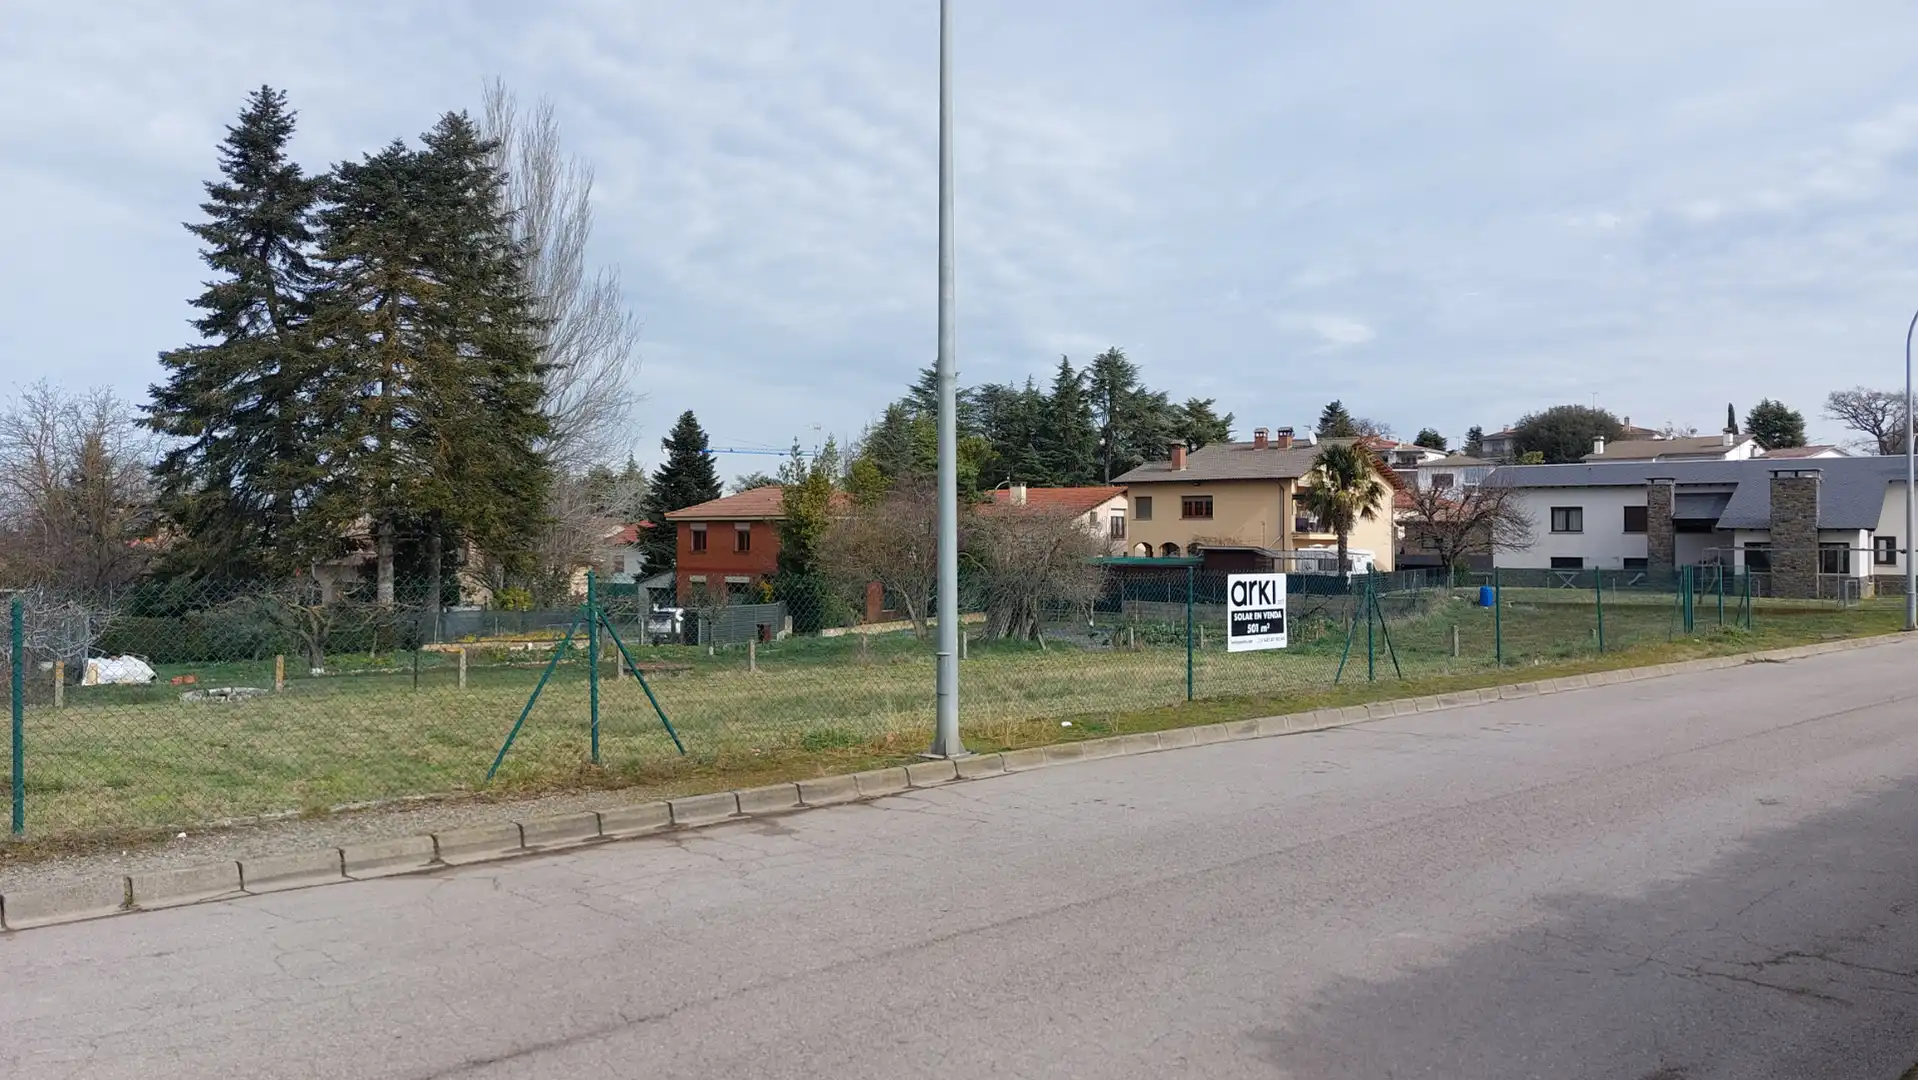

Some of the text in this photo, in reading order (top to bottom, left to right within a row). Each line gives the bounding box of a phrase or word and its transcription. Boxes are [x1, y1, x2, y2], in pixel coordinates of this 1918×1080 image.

[1234, 610, 1282, 621] SOLAR EN VENDA
[1247, 623, 1259, 634] 501
